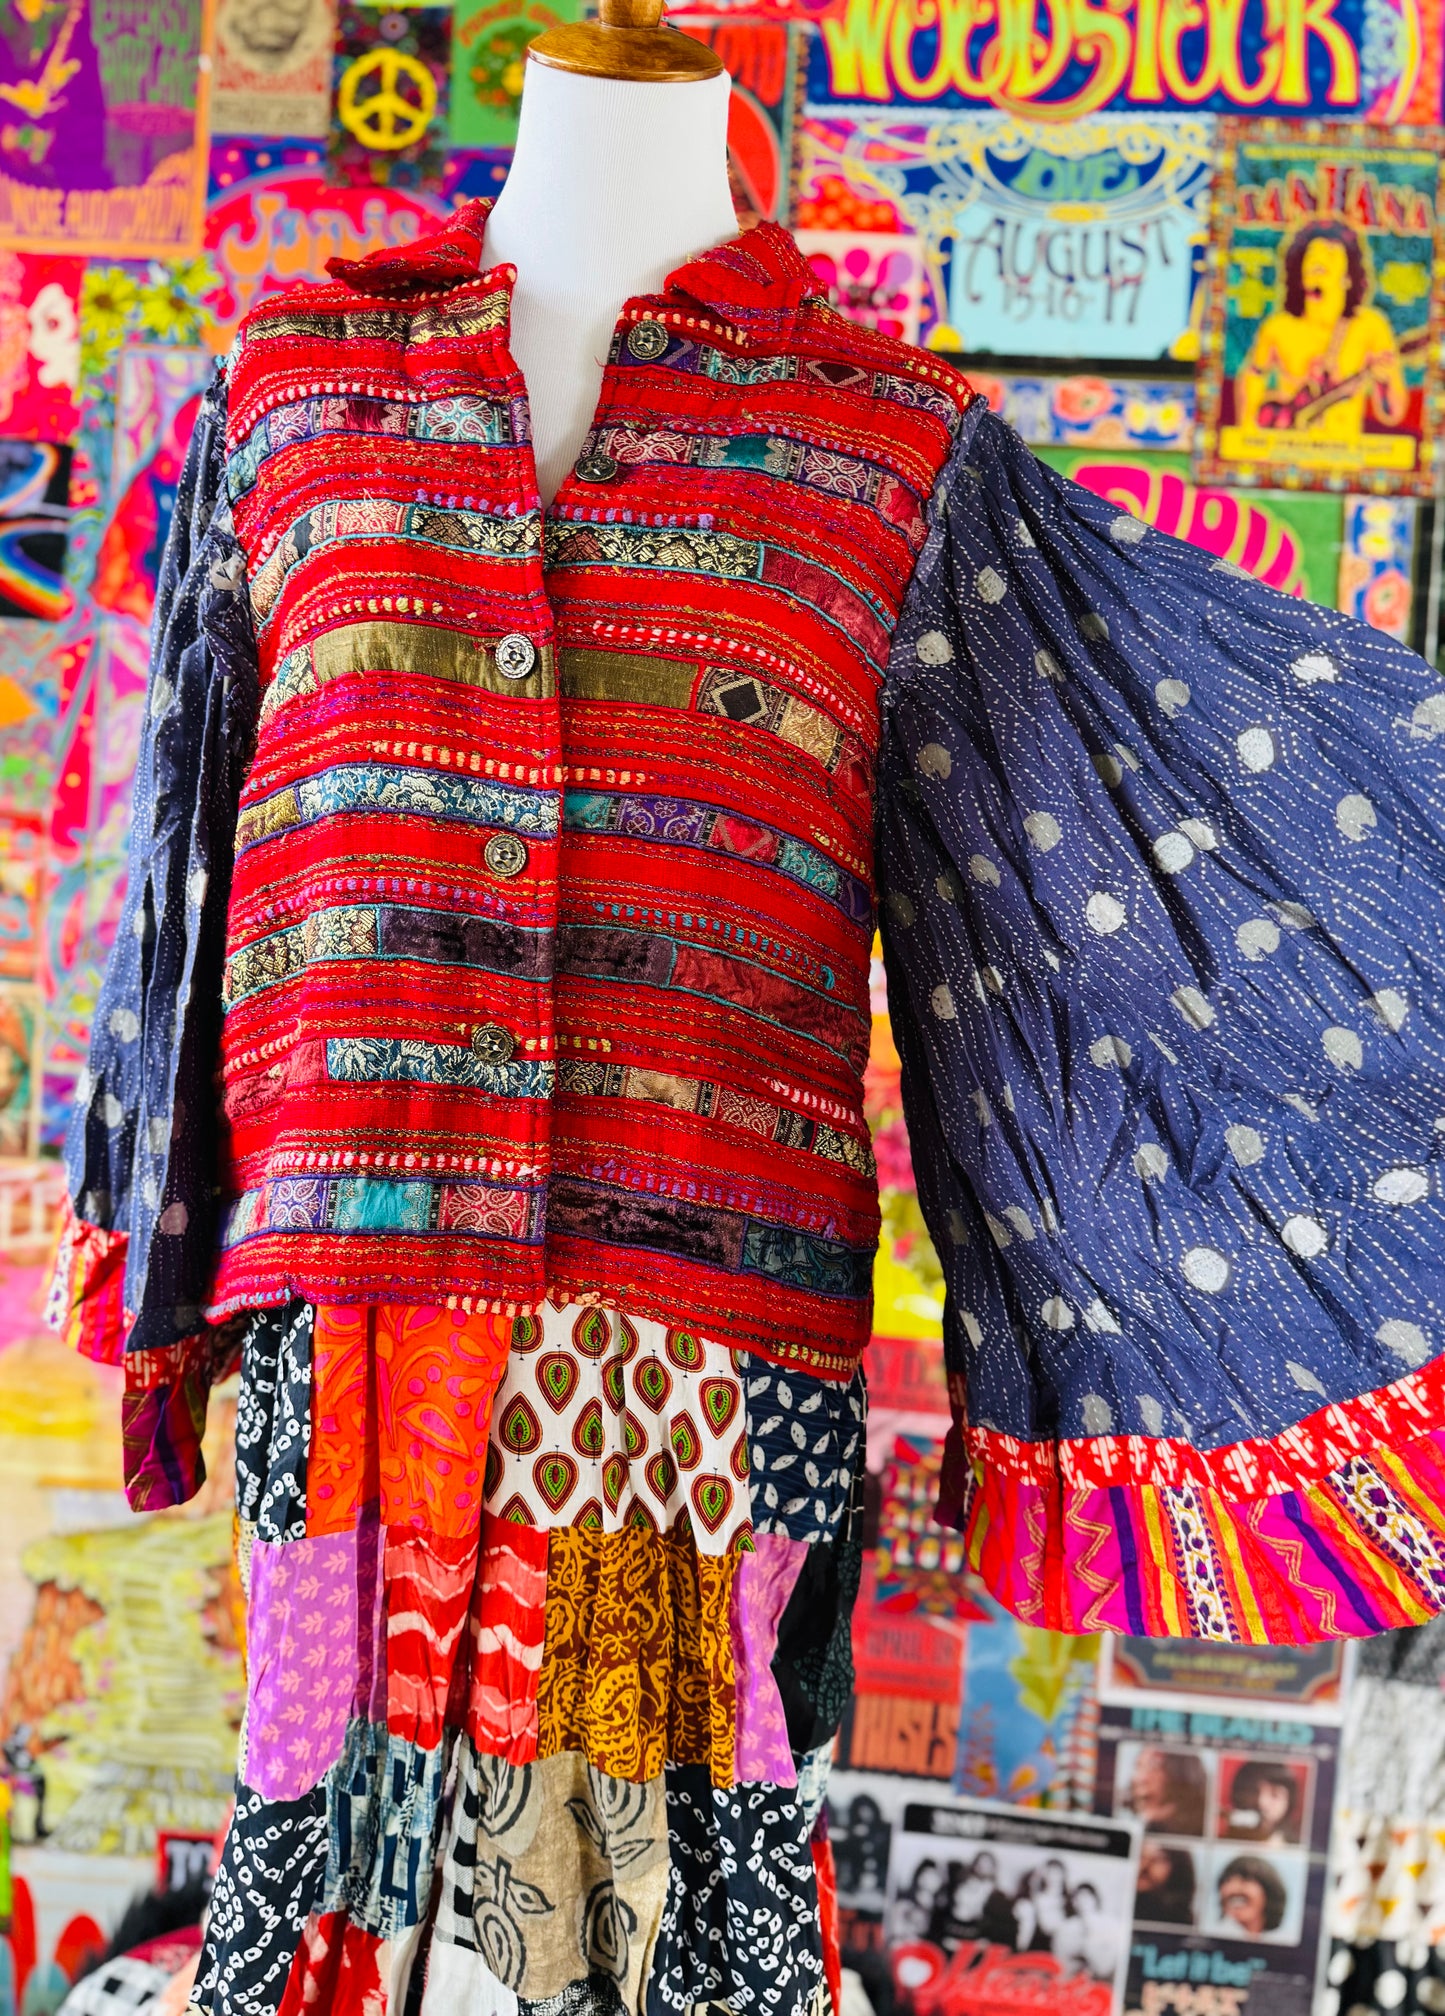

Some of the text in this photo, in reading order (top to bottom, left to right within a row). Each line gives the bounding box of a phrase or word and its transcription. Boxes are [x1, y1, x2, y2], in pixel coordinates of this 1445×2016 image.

[822, 0, 1362, 120] WOODSTOCK
[1236, 164, 1436, 238] SANTANA
[964, 214, 1180, 306] AUGUST
